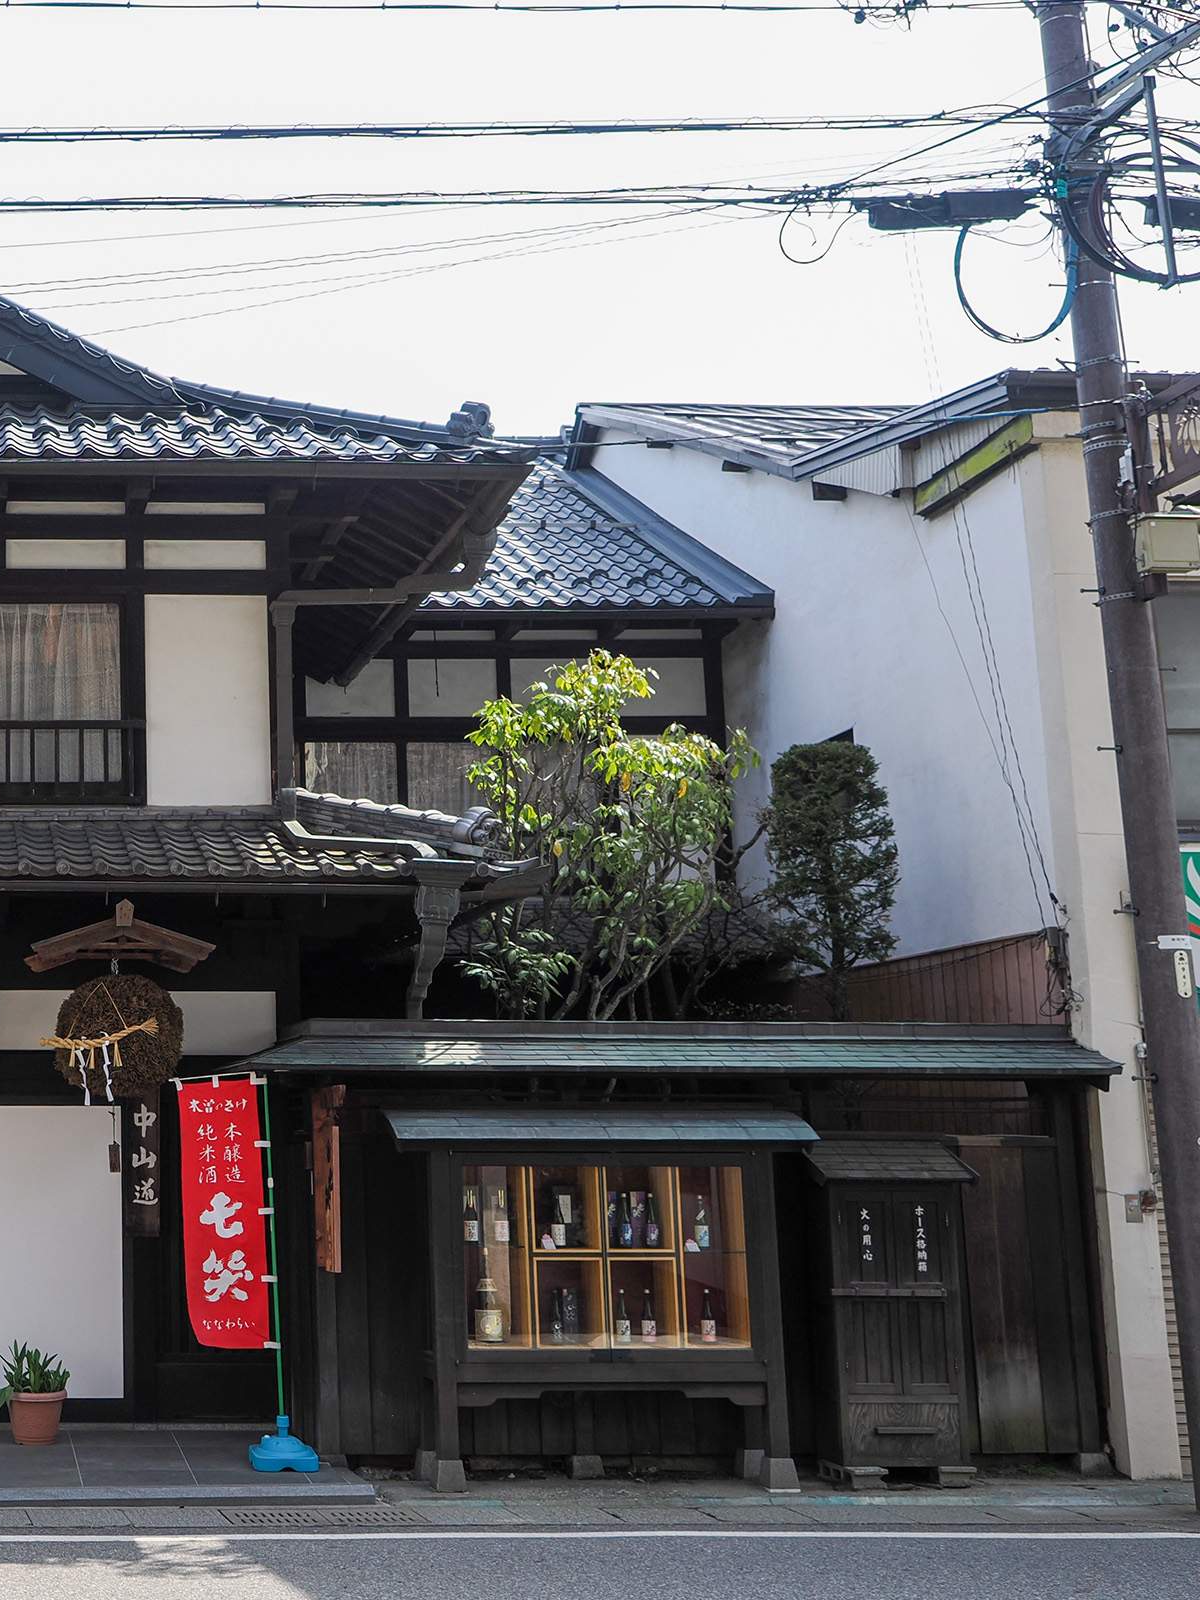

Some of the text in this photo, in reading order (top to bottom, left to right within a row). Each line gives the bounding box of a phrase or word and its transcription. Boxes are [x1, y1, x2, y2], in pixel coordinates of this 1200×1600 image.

[131, 1103, 159, 1206] 中山道
[196, 1124, 218, 1184] 純米酒
[222, 1122, 246, 1183] 本醸造
[860, 1208, 873, 1261] 火の用心
[915, 1205, 927, 1272] ホース格納箱
[203, 1318, 256, 1330] ななわらい
